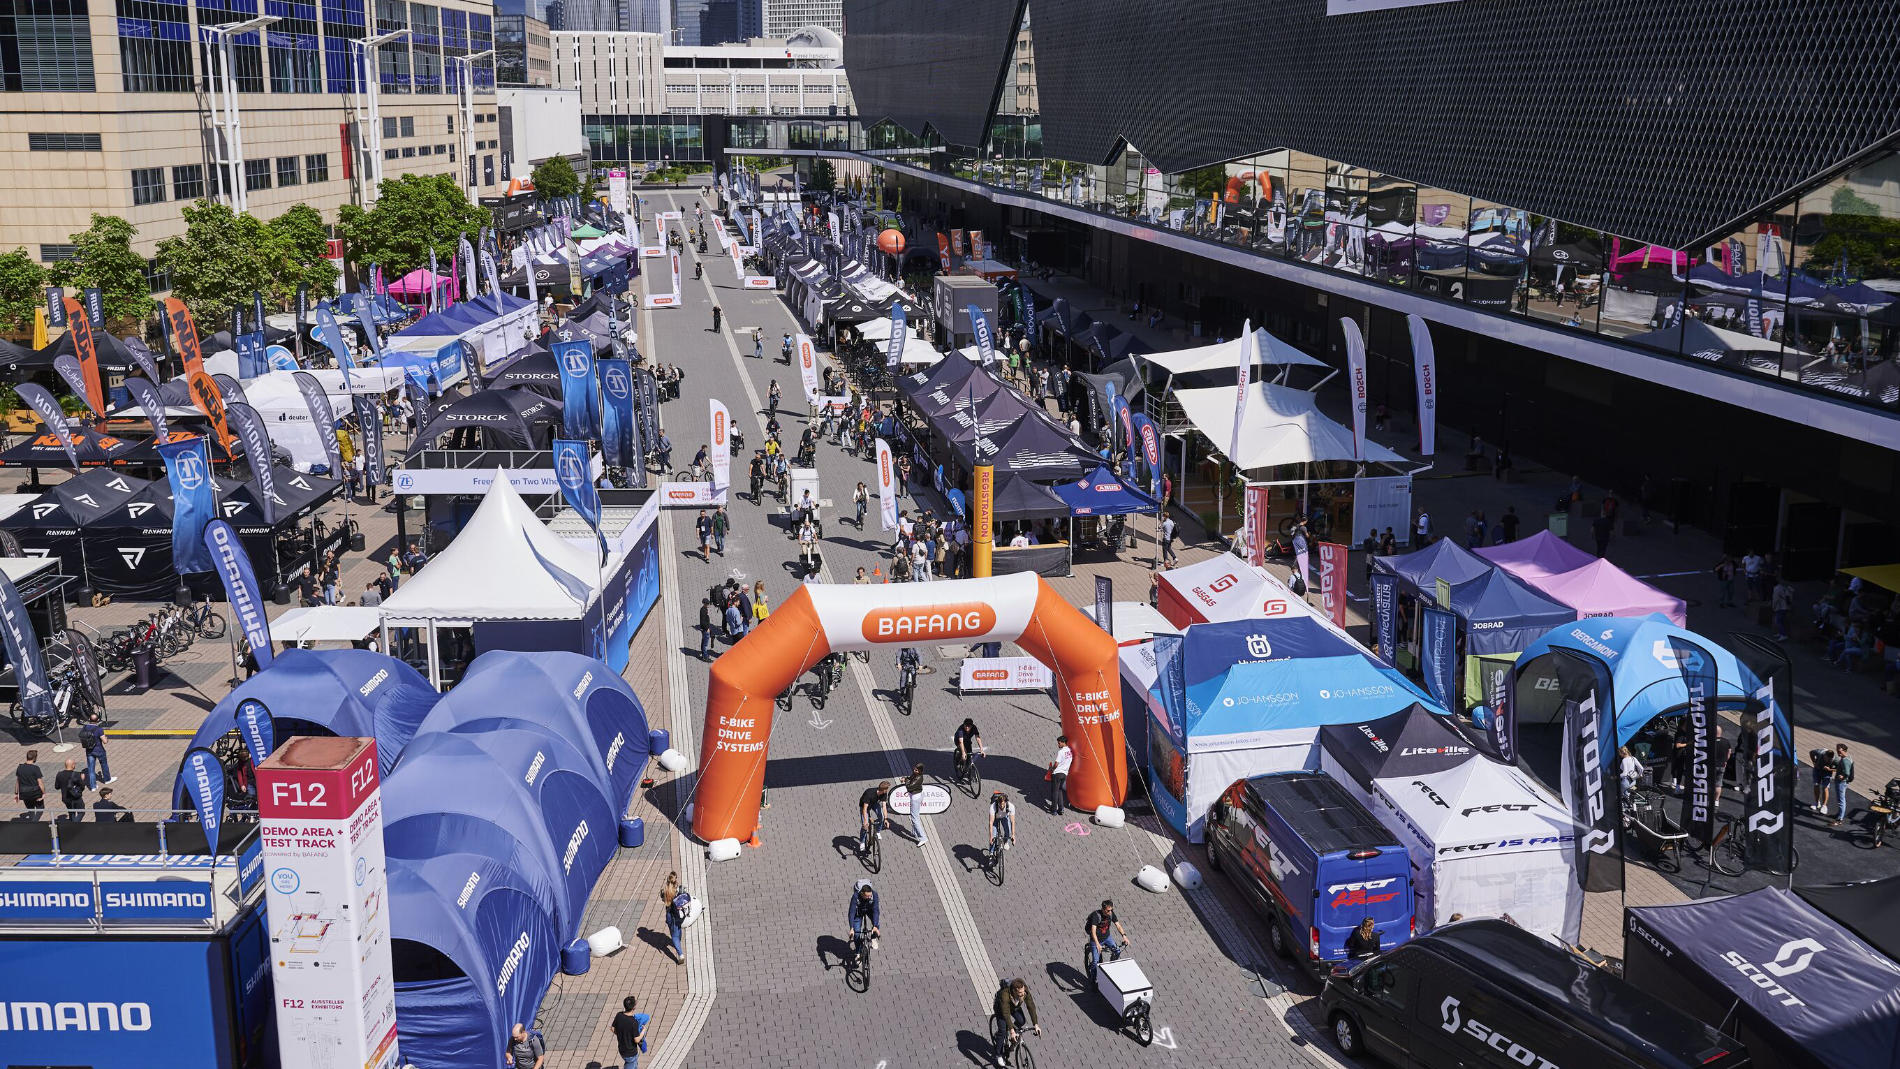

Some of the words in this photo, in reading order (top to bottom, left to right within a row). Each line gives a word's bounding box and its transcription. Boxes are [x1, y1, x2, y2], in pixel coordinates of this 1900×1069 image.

[520, 402, 546, 418] STORCK
[473, 478, 494, 486] Free
[523, 477, 540, 485] Two
[1192, 586, 1217, 607] GASGAS
[1418, 592, 1433, 607] JOBRAD
[878, 612, 981, 635] BAFANG
[1473, 621, 1504, 630] JOBRAD
[1570, 629, 1618, 660] BERGAMONT
[359, 668, 389, 697] SHIMANO
[573, 671, 593, 700] SHIMANO
[1333, 685, 1394, 699] JOHANSSON
[1076, 690, 1109, 701] E-BIKE
[1237, 691, 1299, 705] JOHANSSON
[1077, 703, 1108, 713] DRIVE
[1078, 710, 1120, 725] SYSTEMS
[719, 716, 755, 728] E-BIKE
[718, 728, 751, 740] DRIVE
[1357, 725, 1389, 752] Liteville
[606, 731, 625, 775] SHIMANO
[716, 741, 764, 753] SYSTEMS
[1400, 745, 1470, 757] Liteville
[351, 758, 374, 799] F12
[525, 751, 545, 787] SHIMANO
[272, 782, 327, 807] F12
[1412, 780, 1450, 809] FELT
[350, 812, 364, 834] DEMO
[364, 800, 377, 817] AREA
[1461, 804, 1538, 817] FELT
[262, 827, 298, 836] DEMO
[302, 827, 334, 836] AREA
[350, 831, 361, 844] TEST
[362, 810, 379, 831] TRACK
[1395, 810, 1406, 825] IS
[1407, 823, 1434, 850] FAST
[263, 838, 291, 848] TEST
[294, 838, 336, 848] TRACK
[563, 819, 590, 876] SHIMANO
[1438, 841, 1496, 855] FELT
[1498, 838, 1523, 848] IS
[241, 852, 263, 881] SHIMA
[457, 871, 481, 909] SHIMANO
[1328, 877, 1396, 894] FELT
[0, 893, 90, 907] SHIMANO
[105, 893, 206, 907] SHIMANO
[1636, 926, 1675, 958] SCOTT
[498, 931, 530, 997] SHIMANO
[246, 956, 272, 995] SHIMA
[1719, 950, 1806, 1008] SCOTT
[283, 999, 305, 1009] F12
[0, 1002, 152, 1031] IMANO
